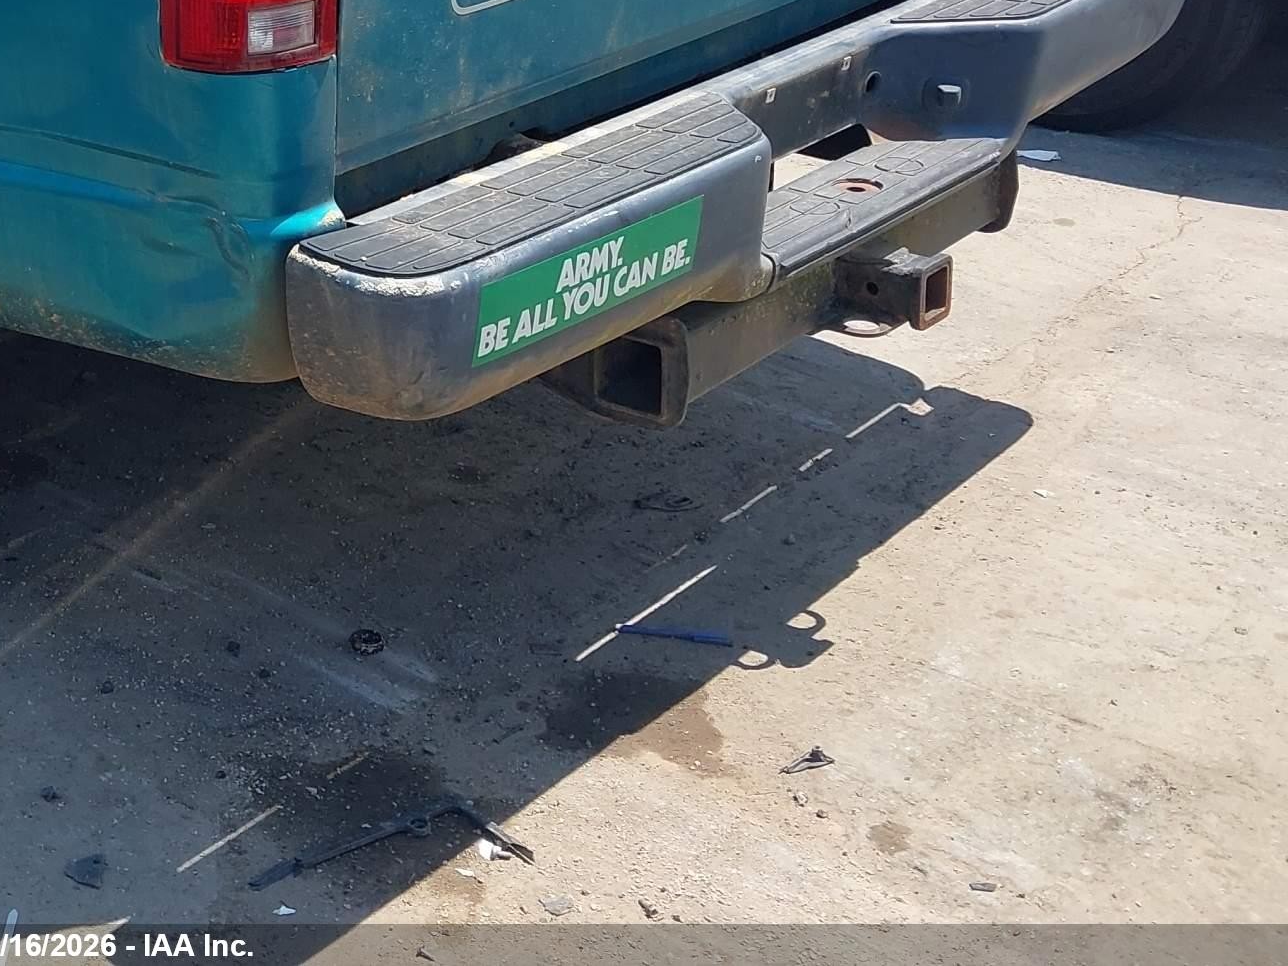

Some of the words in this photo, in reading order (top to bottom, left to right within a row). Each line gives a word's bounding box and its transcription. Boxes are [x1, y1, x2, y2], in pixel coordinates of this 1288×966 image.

[477, 317, 511, 358] BE
[512, 298, 558, 344] ALL
[562, 274, 610, 321] YOU
[614, 251, 659, 298] CAN
[660, 238, 691, 276] BE.
[555, 236, 625, 294] ARMY.
